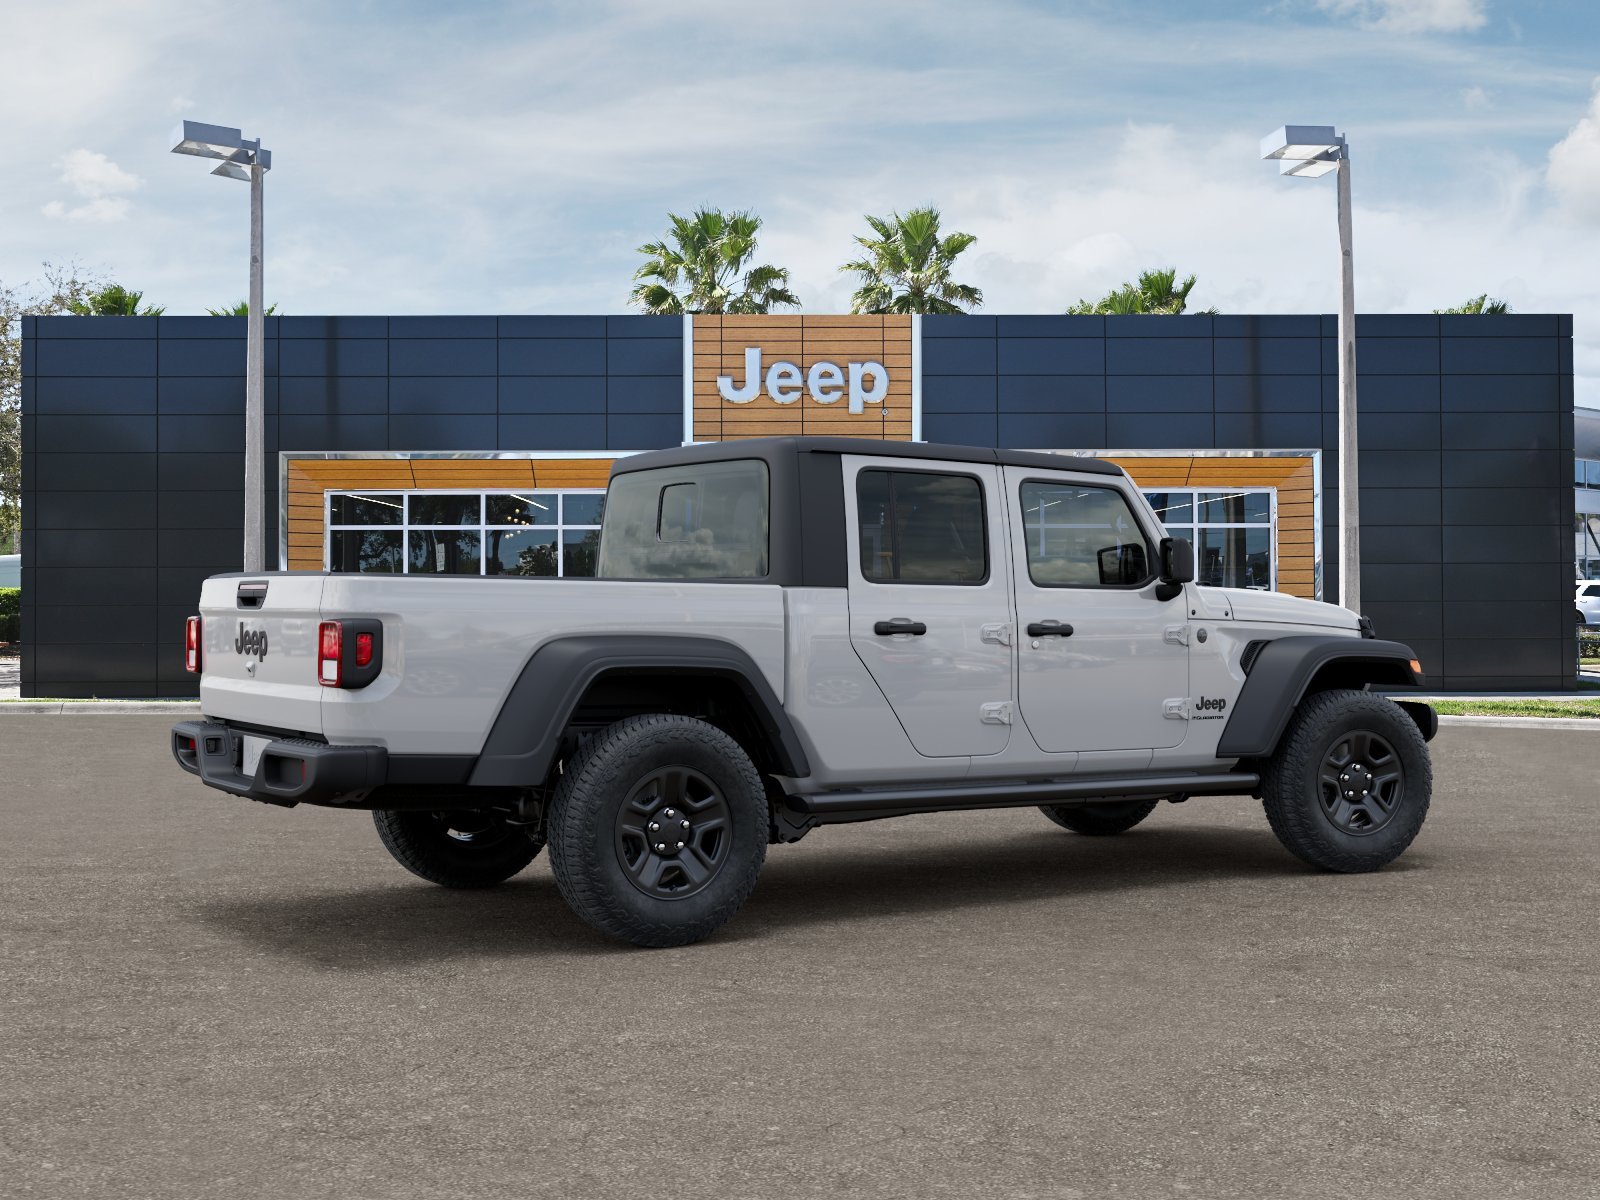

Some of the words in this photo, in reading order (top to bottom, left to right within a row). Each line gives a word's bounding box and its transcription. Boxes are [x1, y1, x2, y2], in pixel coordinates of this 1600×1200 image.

[716, 346, 890, 415] Jeep
[235, 621, 268, 662] Jeep
[1195, 696, 1226, 712] Jeep
